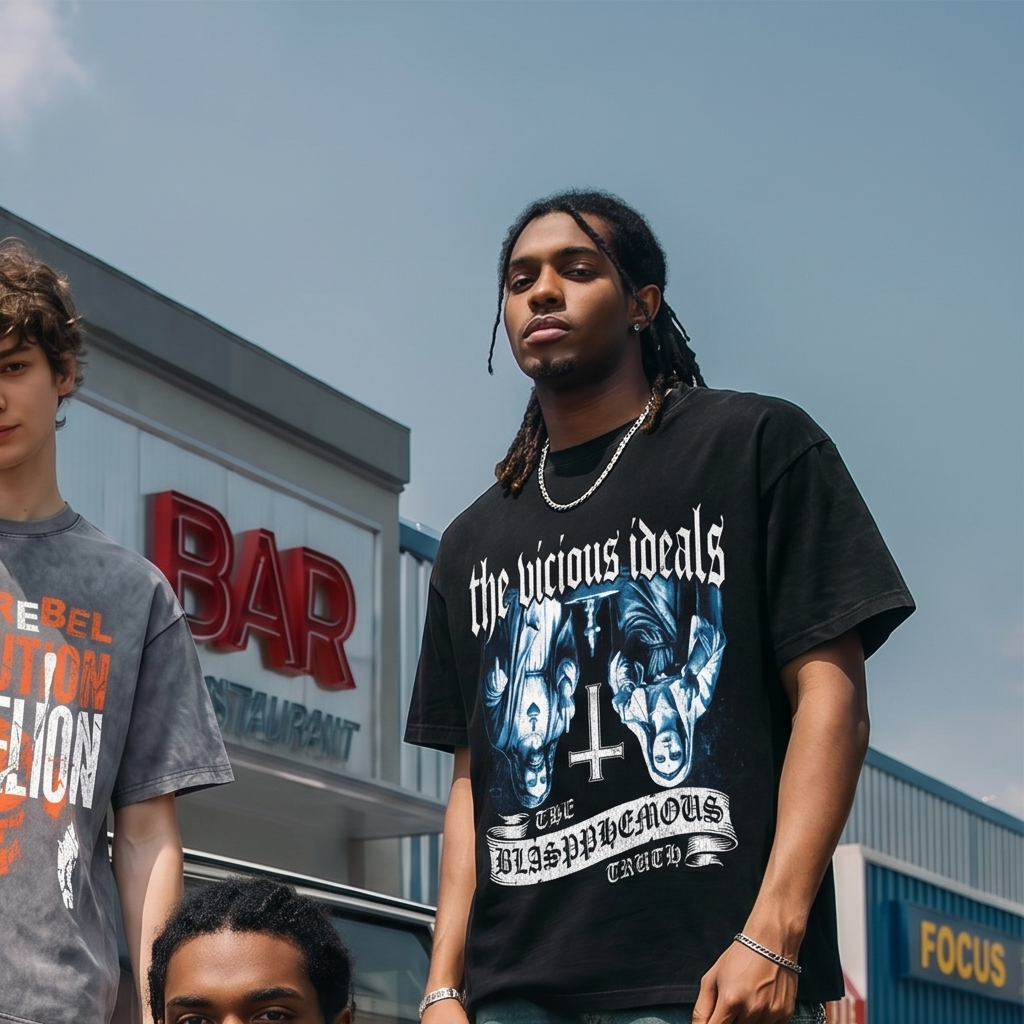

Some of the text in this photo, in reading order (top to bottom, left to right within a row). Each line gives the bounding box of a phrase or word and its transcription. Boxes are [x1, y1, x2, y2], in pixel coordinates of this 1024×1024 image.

[150, 489, 357, 690] BAR
[469, 503, 726, 644] the vicious ideals
[535, 798, 575, 830] THE
[920, 920, 1006, 988] FOCUS
